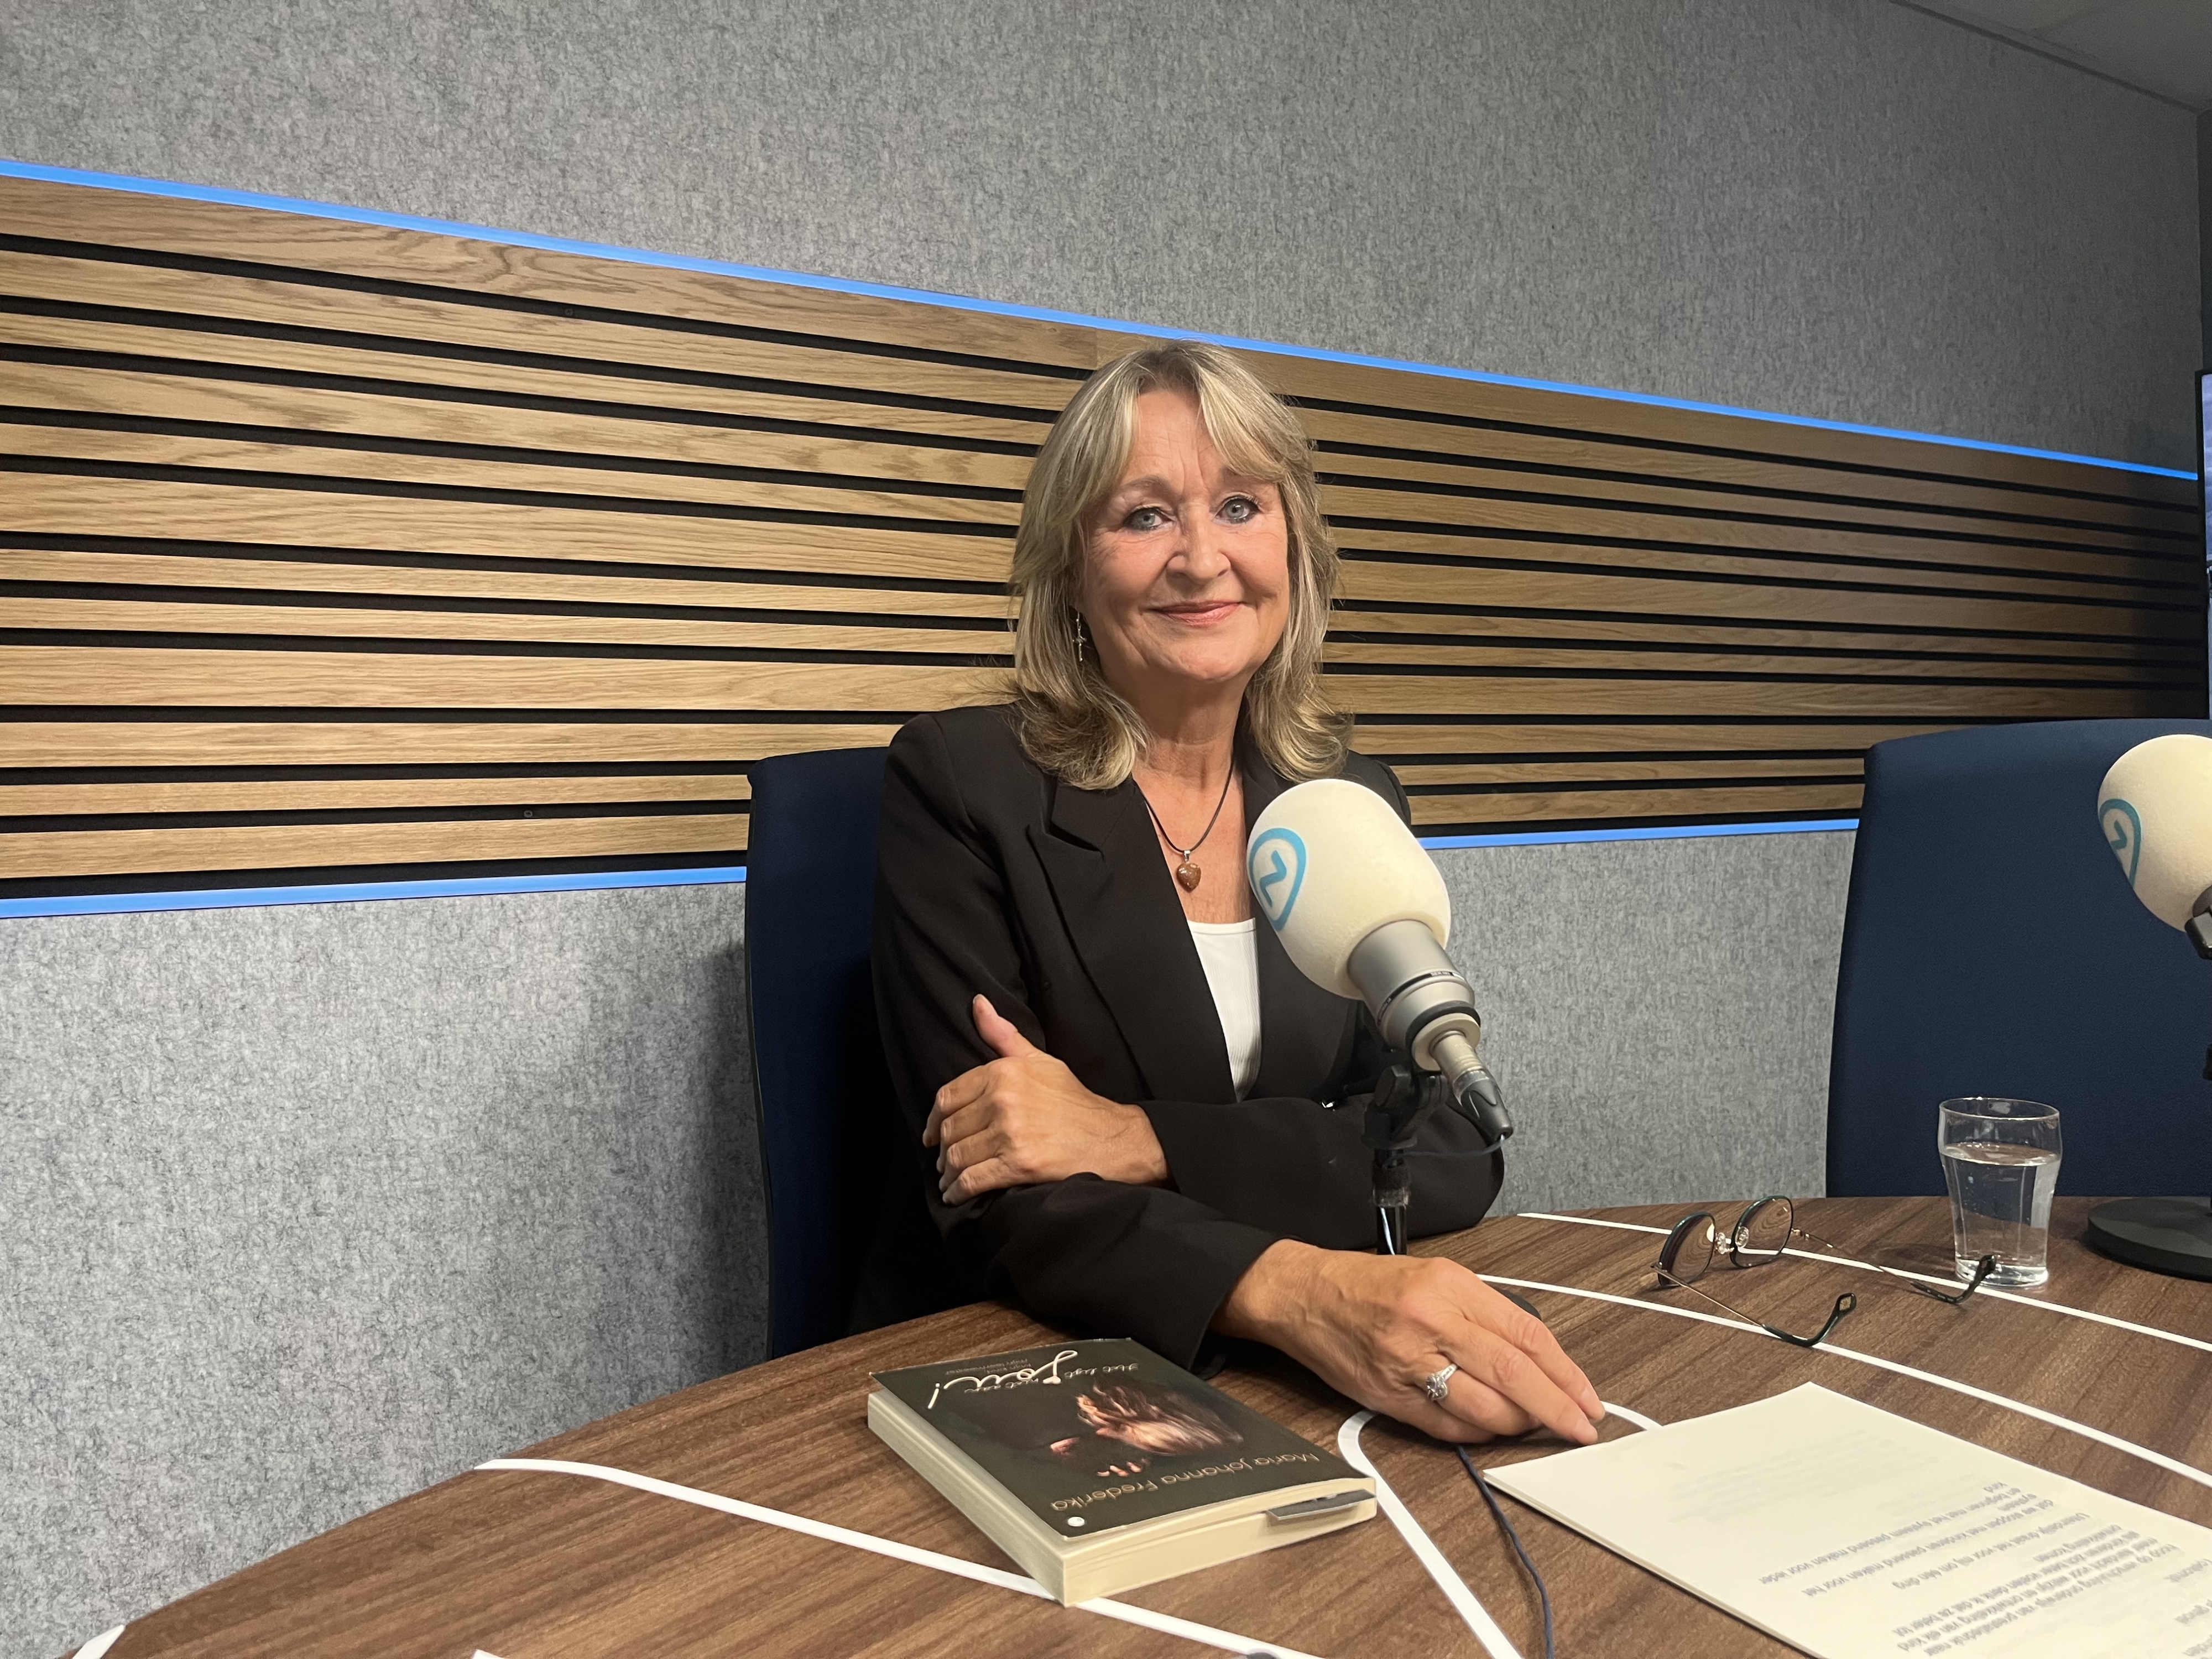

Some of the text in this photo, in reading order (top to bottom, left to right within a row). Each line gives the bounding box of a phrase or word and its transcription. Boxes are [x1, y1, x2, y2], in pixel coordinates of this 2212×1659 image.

[1065, 1368, 1098, 1379] ligt
[1103, 1363, 1139, 1373] Het
[927, 1350, 1078, 1409] jou!
[964, 1384, 1001, 1394] aan
[1051, 1452, 1321, 1511] Maria Johanna Frederika
